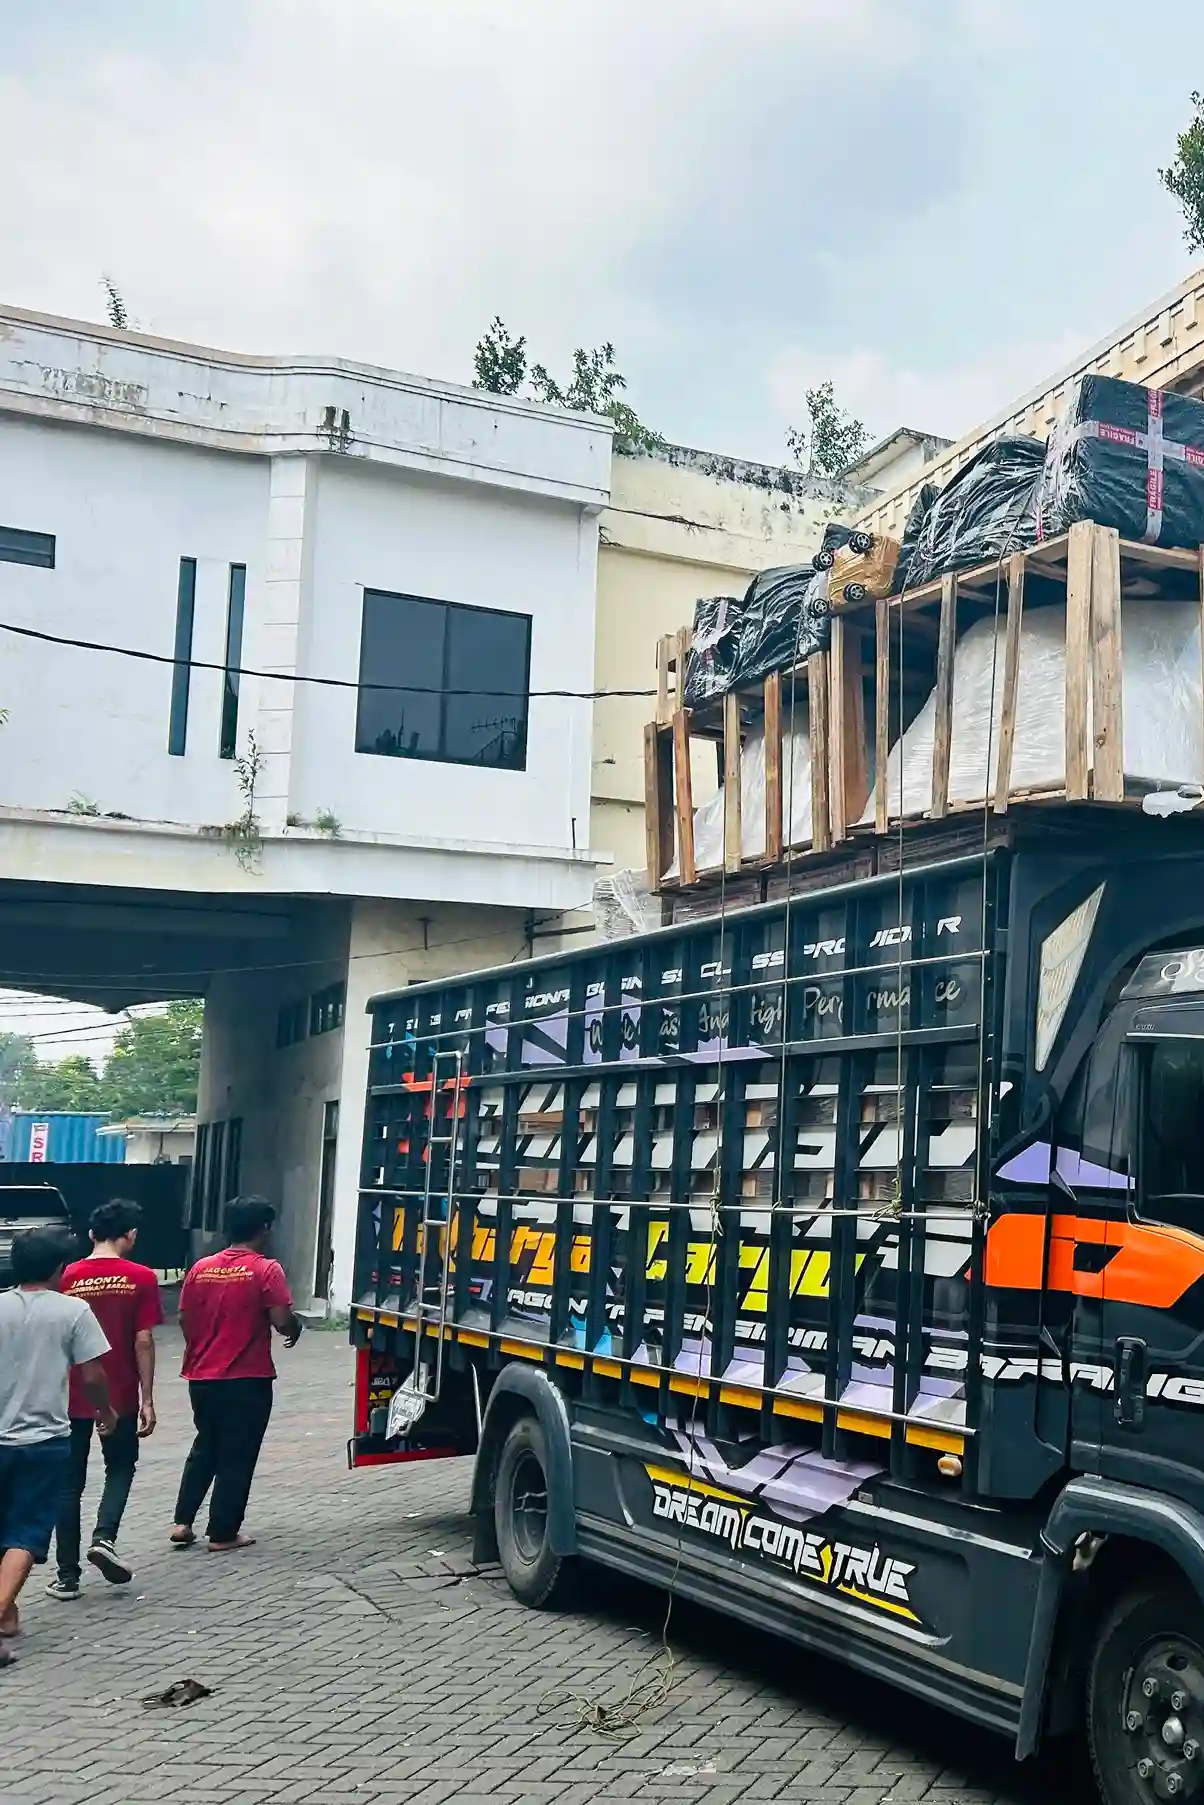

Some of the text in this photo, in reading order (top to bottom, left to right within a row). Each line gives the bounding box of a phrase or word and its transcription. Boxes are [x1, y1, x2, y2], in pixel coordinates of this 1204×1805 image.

[1100, 428, 1136, 444] FRAGILE
[700, 950, 785, 979] CLSS
[803, 915, 962, 958] PROIDR
[71, 1276, 128, 1289] JAGONYA
[653, 1484, 916, 1601] DREAM COME TRUE
